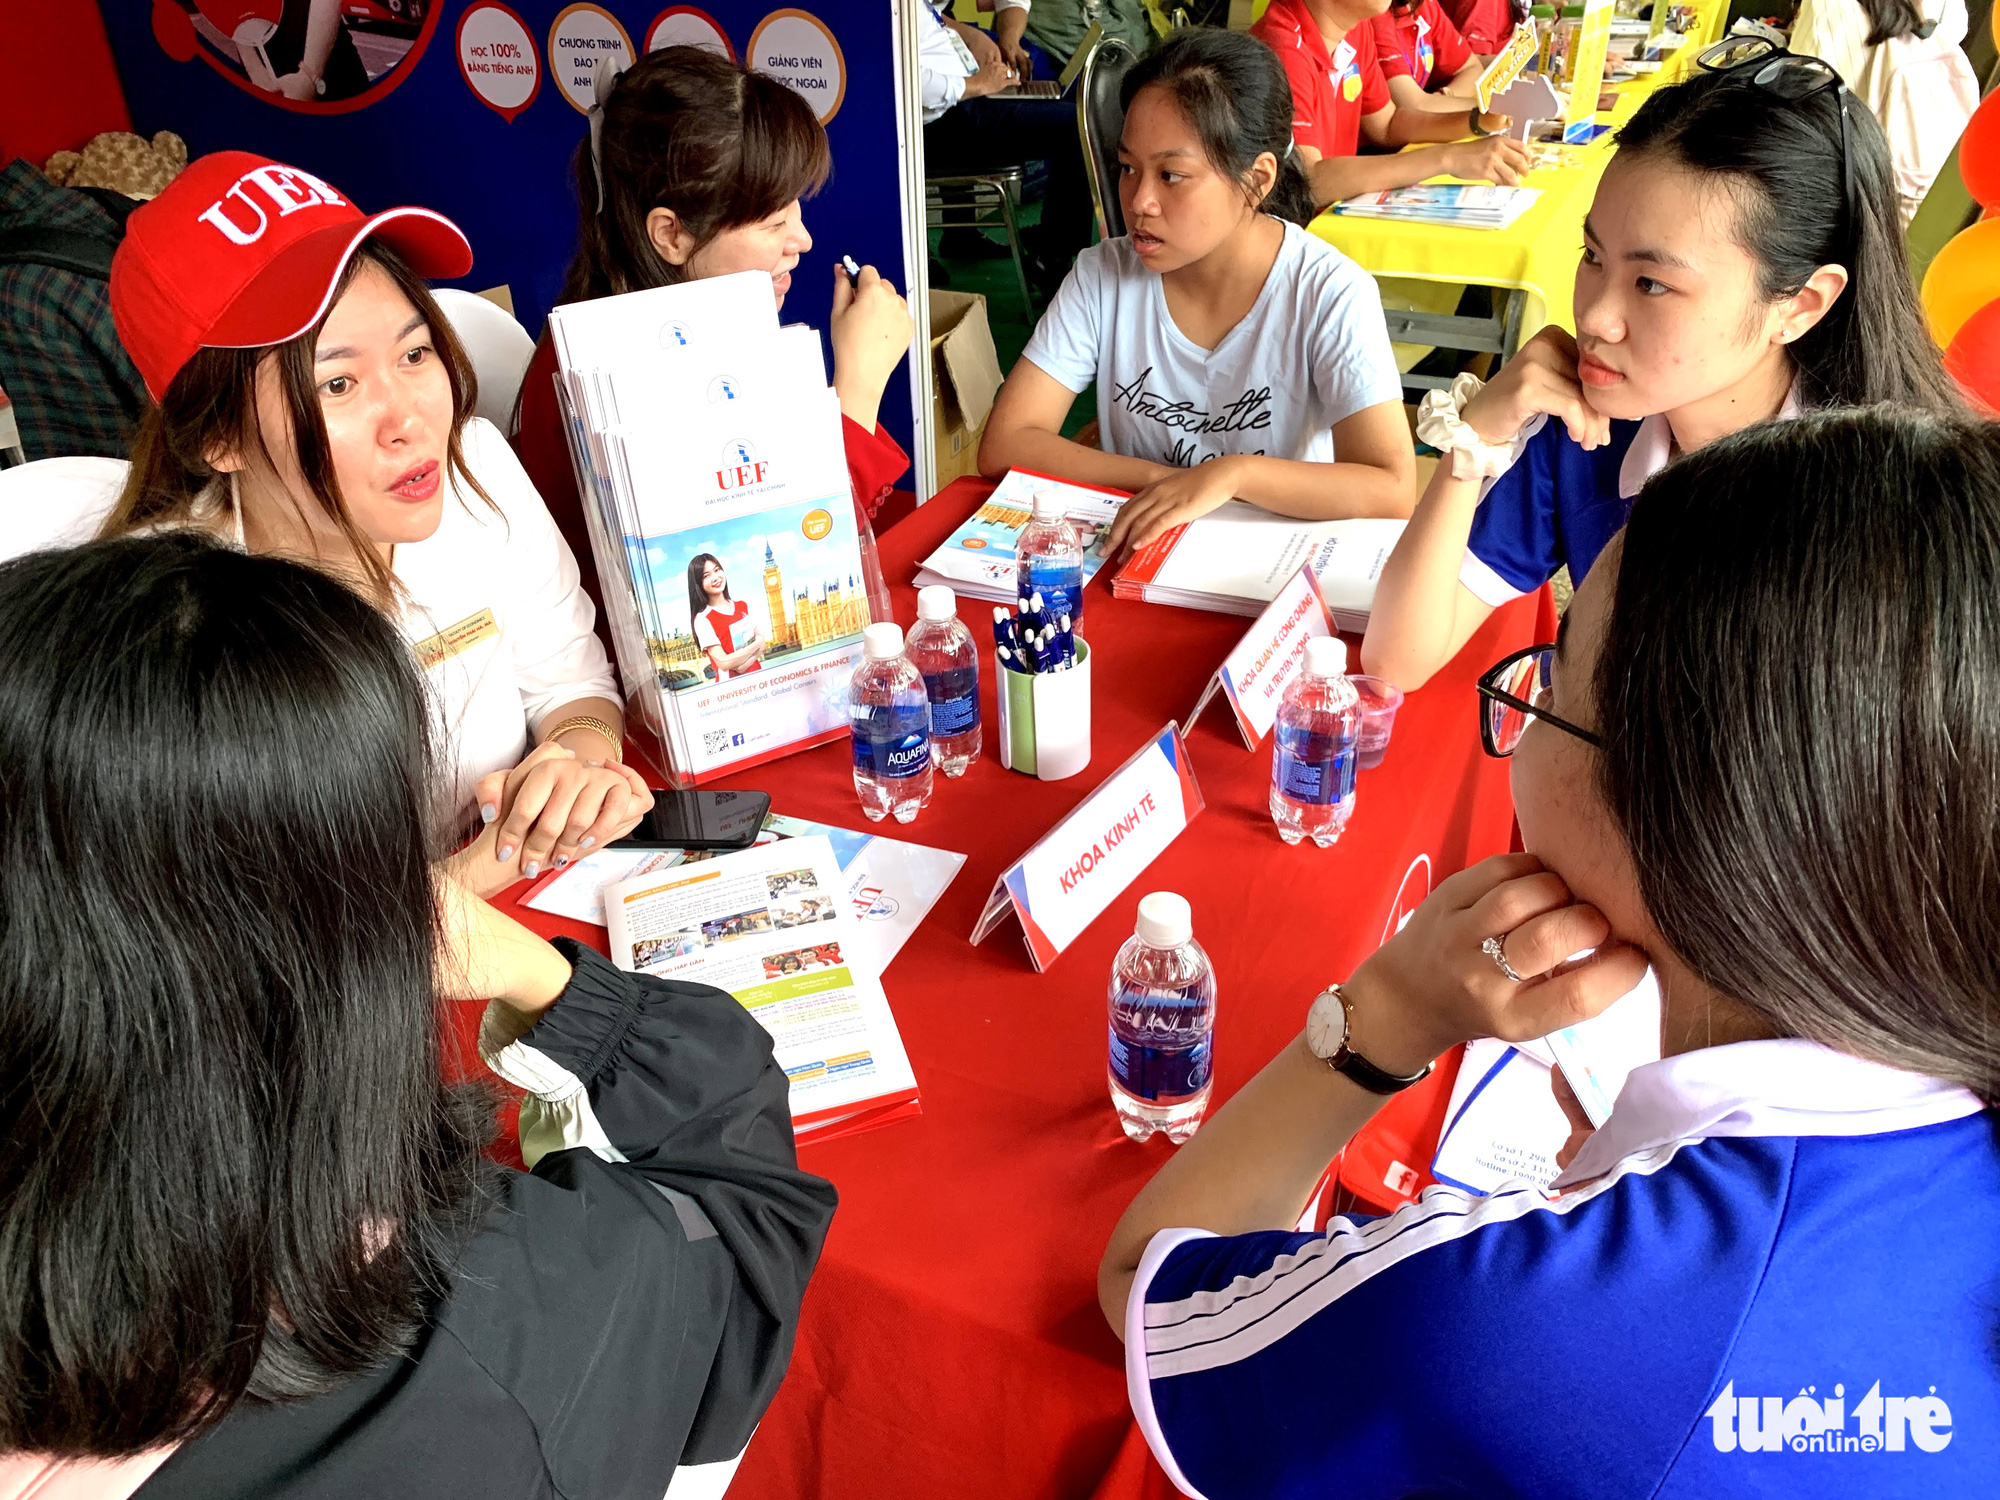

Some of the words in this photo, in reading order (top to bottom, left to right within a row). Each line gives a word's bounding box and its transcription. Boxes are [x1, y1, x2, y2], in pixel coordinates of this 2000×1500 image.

[470, 46, 488, 58] HỌC
[490, 43, 521, 58] 100%
[559, 37, 595, 49] CHƯƠNG
[597, 37, 621, 49] TRÌNH
[491, 62, 514, 74] TIẾNG
[516, 65, 534, 75] ANH
[574, 55, 593, 68] ĐÀO
[768, 53, 799, 68] GIẢNG
[800, 56, 822, 69] VIÊN
[574, 76, 592, 87] ANH
[796, 76, 827, 89] NGOÀI
[197, 165, 346, 245] UEF
[1113, 367, 1272, 433] Antoinette
[715, 460, 769, 490] UEF
[809, 522, 826, 534] UEF
[1237, 668, 1257, 696] KHOA
[1254, 646, 1274, 673] QUAN
[697, 698, 711, 708] UEF
[717, 684, 757, 703] UNIVERSITY
[758, 680, 769, 690] OF
[770, 667, 813, 687] ECONOMICS
[820, 655, 850, 672] FINANCE
[770, 685, 793, 697] Global
[1059, 843, 1106, 895] KHOA
[1103, 807, 1141, 852] KINH
[851, 887, 884, 922] UE
[1529, 1152, 1546, 1163] 298
[1475, 1157, 1511, 1176] Hotline:
[1513, 1170, 1537, 1183] 1900
